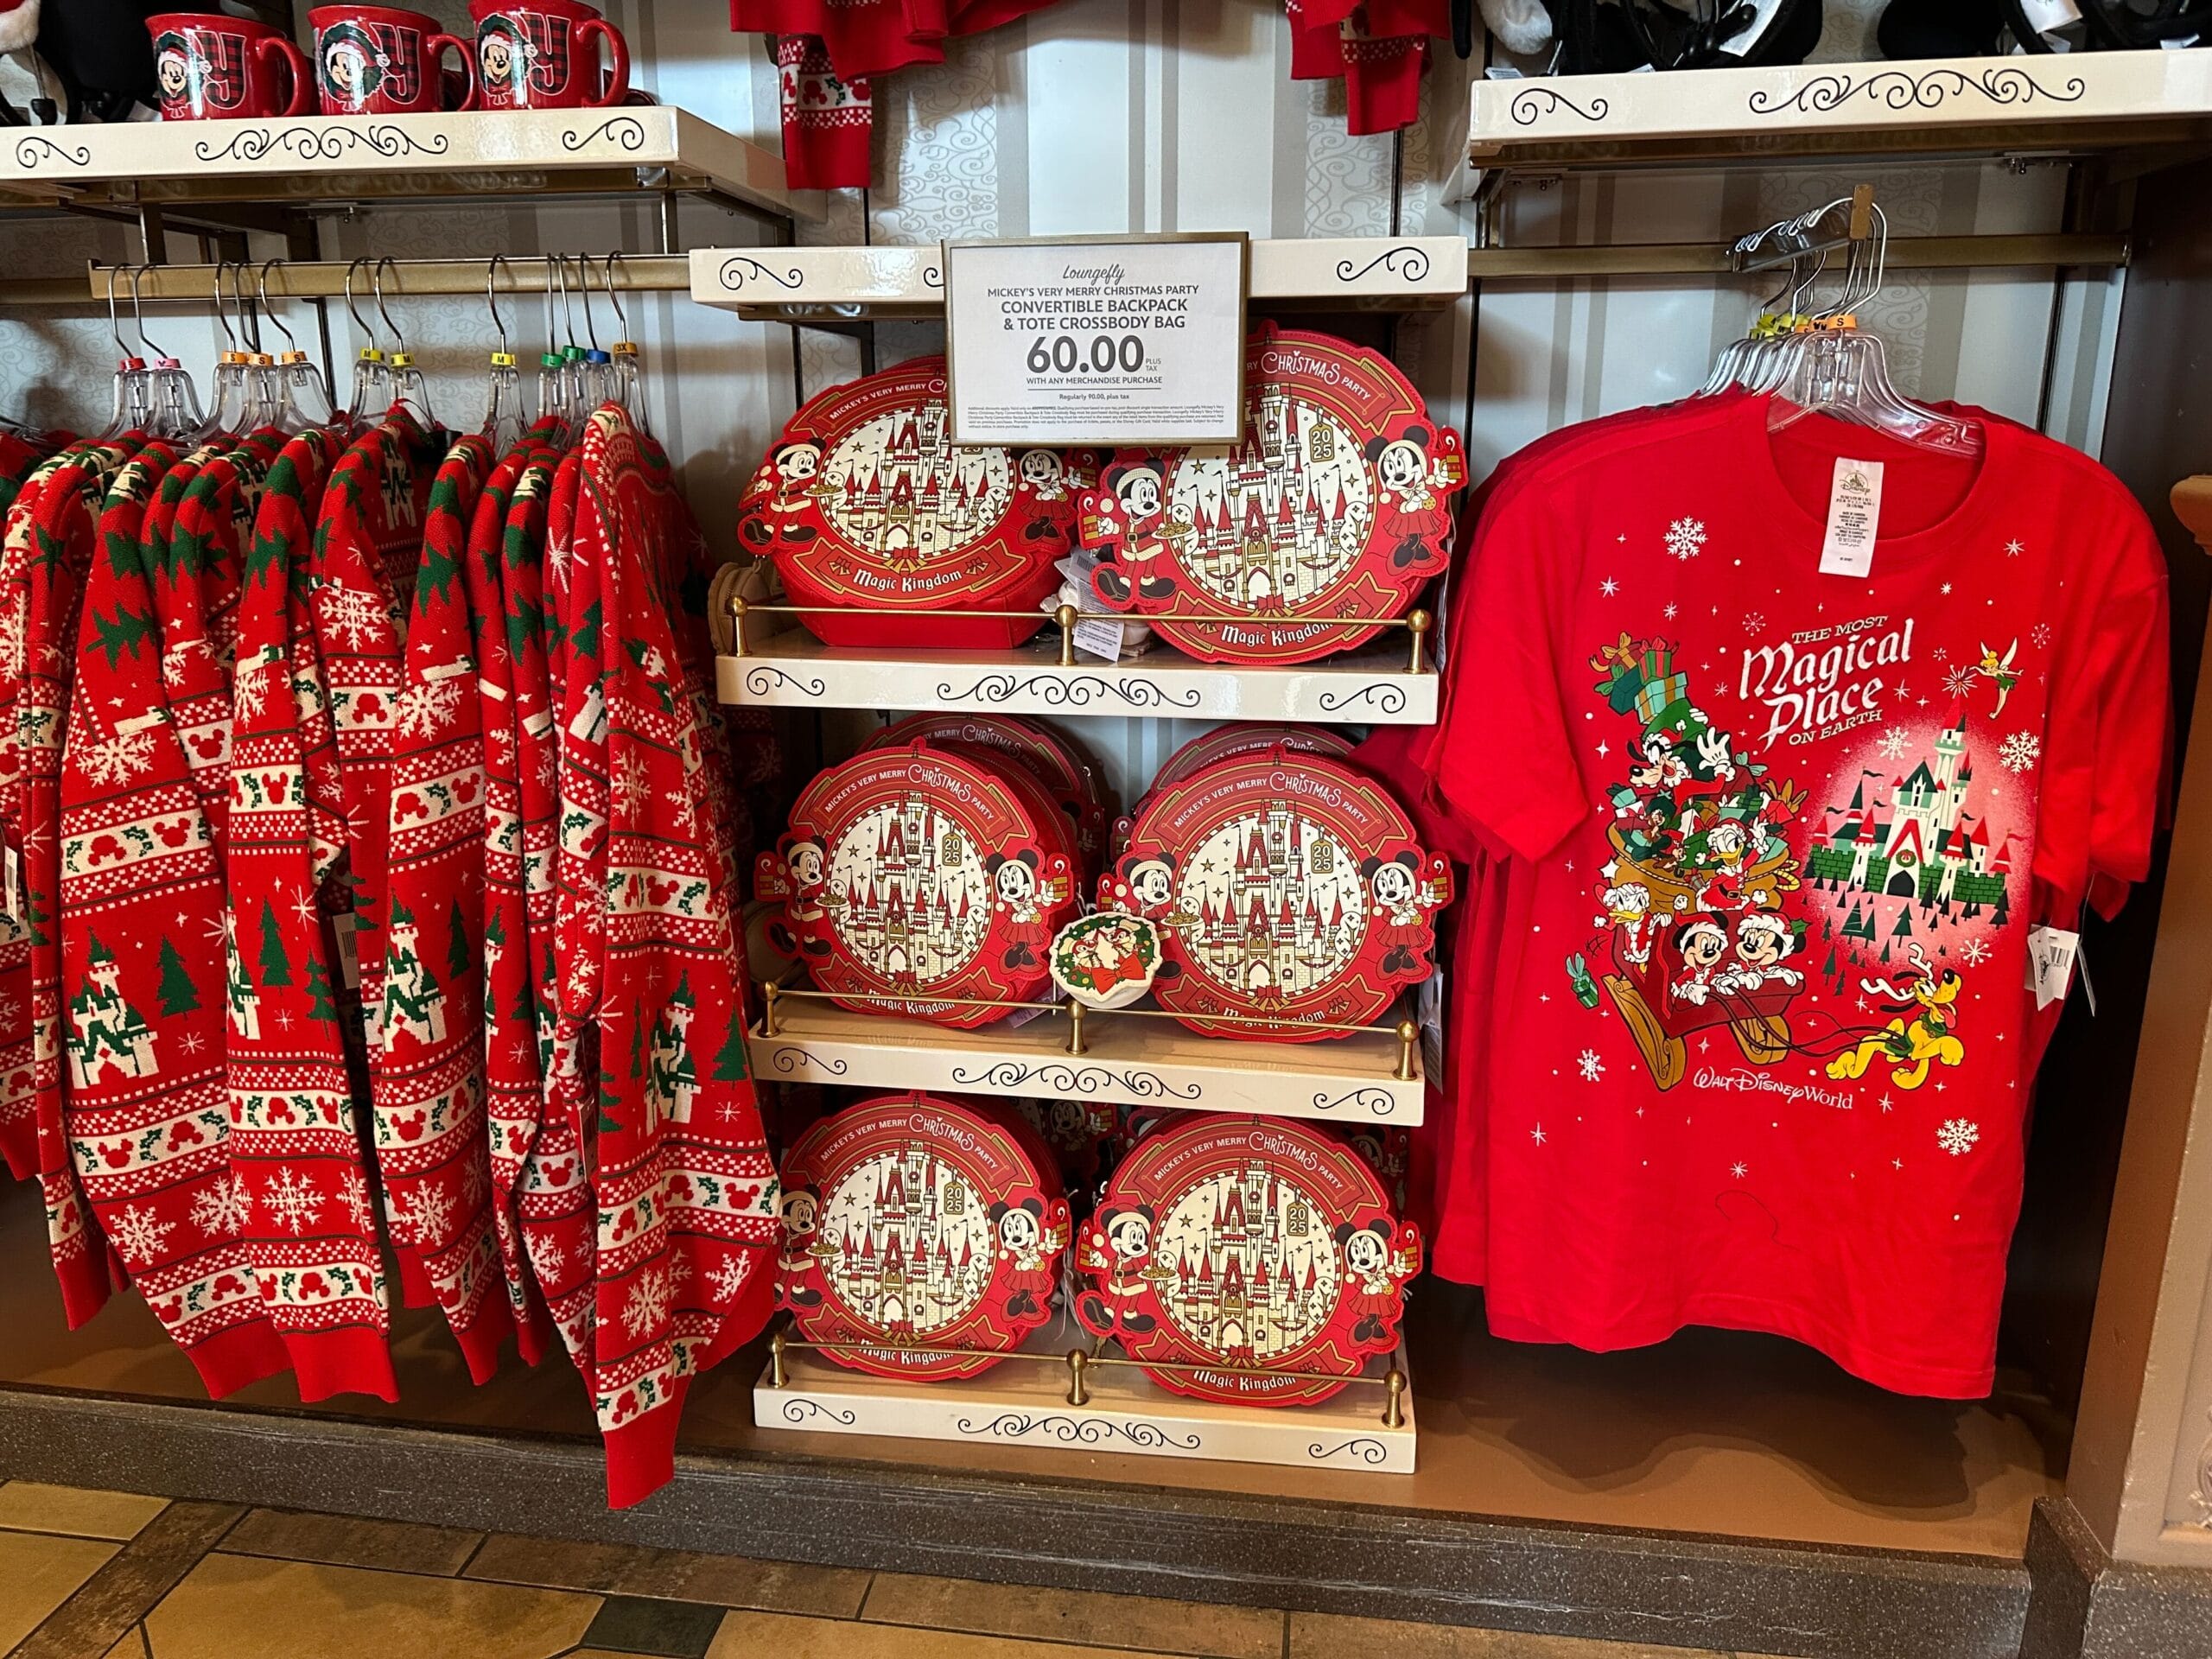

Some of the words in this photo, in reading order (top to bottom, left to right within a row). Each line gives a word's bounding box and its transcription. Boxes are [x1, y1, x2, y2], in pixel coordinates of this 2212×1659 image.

[1063, 264, 1125, 285] Loungefly
[988, 288, 1034, 297] MICKEY'S
[1037, 287, 1063, 297] VERY
[1065, 287, 1101, 296] MERRY
[1104, 286, 1163, 296] CHRISTMAS
[1166, 285, 1199, 295] PARTY
[1001, 300, 1103, 314] CONVERTIBLE
[1108, 299, 1187, 312] BACKPACK
[1004, 318, 1014, 330] &
[1018, 317, 1055, 330] TOTE
[1059, 316, 1150, 329] CROSSBODY
[1154, 315, 1185, 328] BAG
[1027, 335, 1144, 373] 60.00
[1262, 351, 1340, 385] CHRISTMAS
[1341, 377, 1372, 401] PARTY
[830, 396, 869, 420] MICKEY'S
[869, 387, 893, 399] VERY
[895, 383, 926, 392] MERRY
[1312, 430, 1332, 444] 20
[1313, 444, 1332, 459] 25
[853, 569, 897, 591] Magic
[902, 570, 963, 593] Kingdom
[1221, 624, 1266, 647] Magic
[1791, 627, 1832, 645] THE
[1834, 615, 1889, 638] MOST
[1738, 617, 1915, 702] Magical
[1758, 677, 1885, 753] Place
[934, 729, 961, 738] MERRY
[1789, 730, 1816, 747] ON
[1819, 709, 1883, 741] EARTH
[824, 784, 857, 813] MICKEY'S
[857, 774, 878, 787] VERY
[880, 769, 907, 779] MERRY
[908, 764, 971, 802] CHRISTMAS
[971, 797, 995, 820] PARTY
[1173, 795, 1211, 828] MICKEY'S
[1211, 785, 1234, 799] VERY
[1237, 778, 1268, 790] MERRY
[1269, 772, 1342, 807] CHRISTMAS
[1342, 800, 1369, 824] PARTY
[945, 838, 960, 850] 20
[1313, 845, 1331, 857] 20
[945, 852, 960, 864] 25
[1313, 859, 1331, 871] 25
[1803, 1085, 1853, 1109] World
[821, 1131, 855, 1161] MICKEY'S
[855, 1123, 876, 1136] VERY
[878, 1118, 907, 1129] MERRY
[909, 1113, 975, 1151] CHRISTMAS
[974, 1146, 998, 1170] PARTY
[1154, 1149, 1191, 1180] MICKEY'S
[1192, 1141, 1214, 1154] VERY
[1217, 1137, 1247, 1147] MERRY
[1249, 1131, 1318, 1171] CHRISTMAS
[1317, 1165, 1343, 1189] PARTY
[947, 1187, 962, 1199] 20
[947, 1199, 963, 1212] 25
[1290, 1208, 1306, 1220] 20
[1289, 1220, 1306, 1233] 25
[1239, 1376, 1296, 1392] Kingdom
